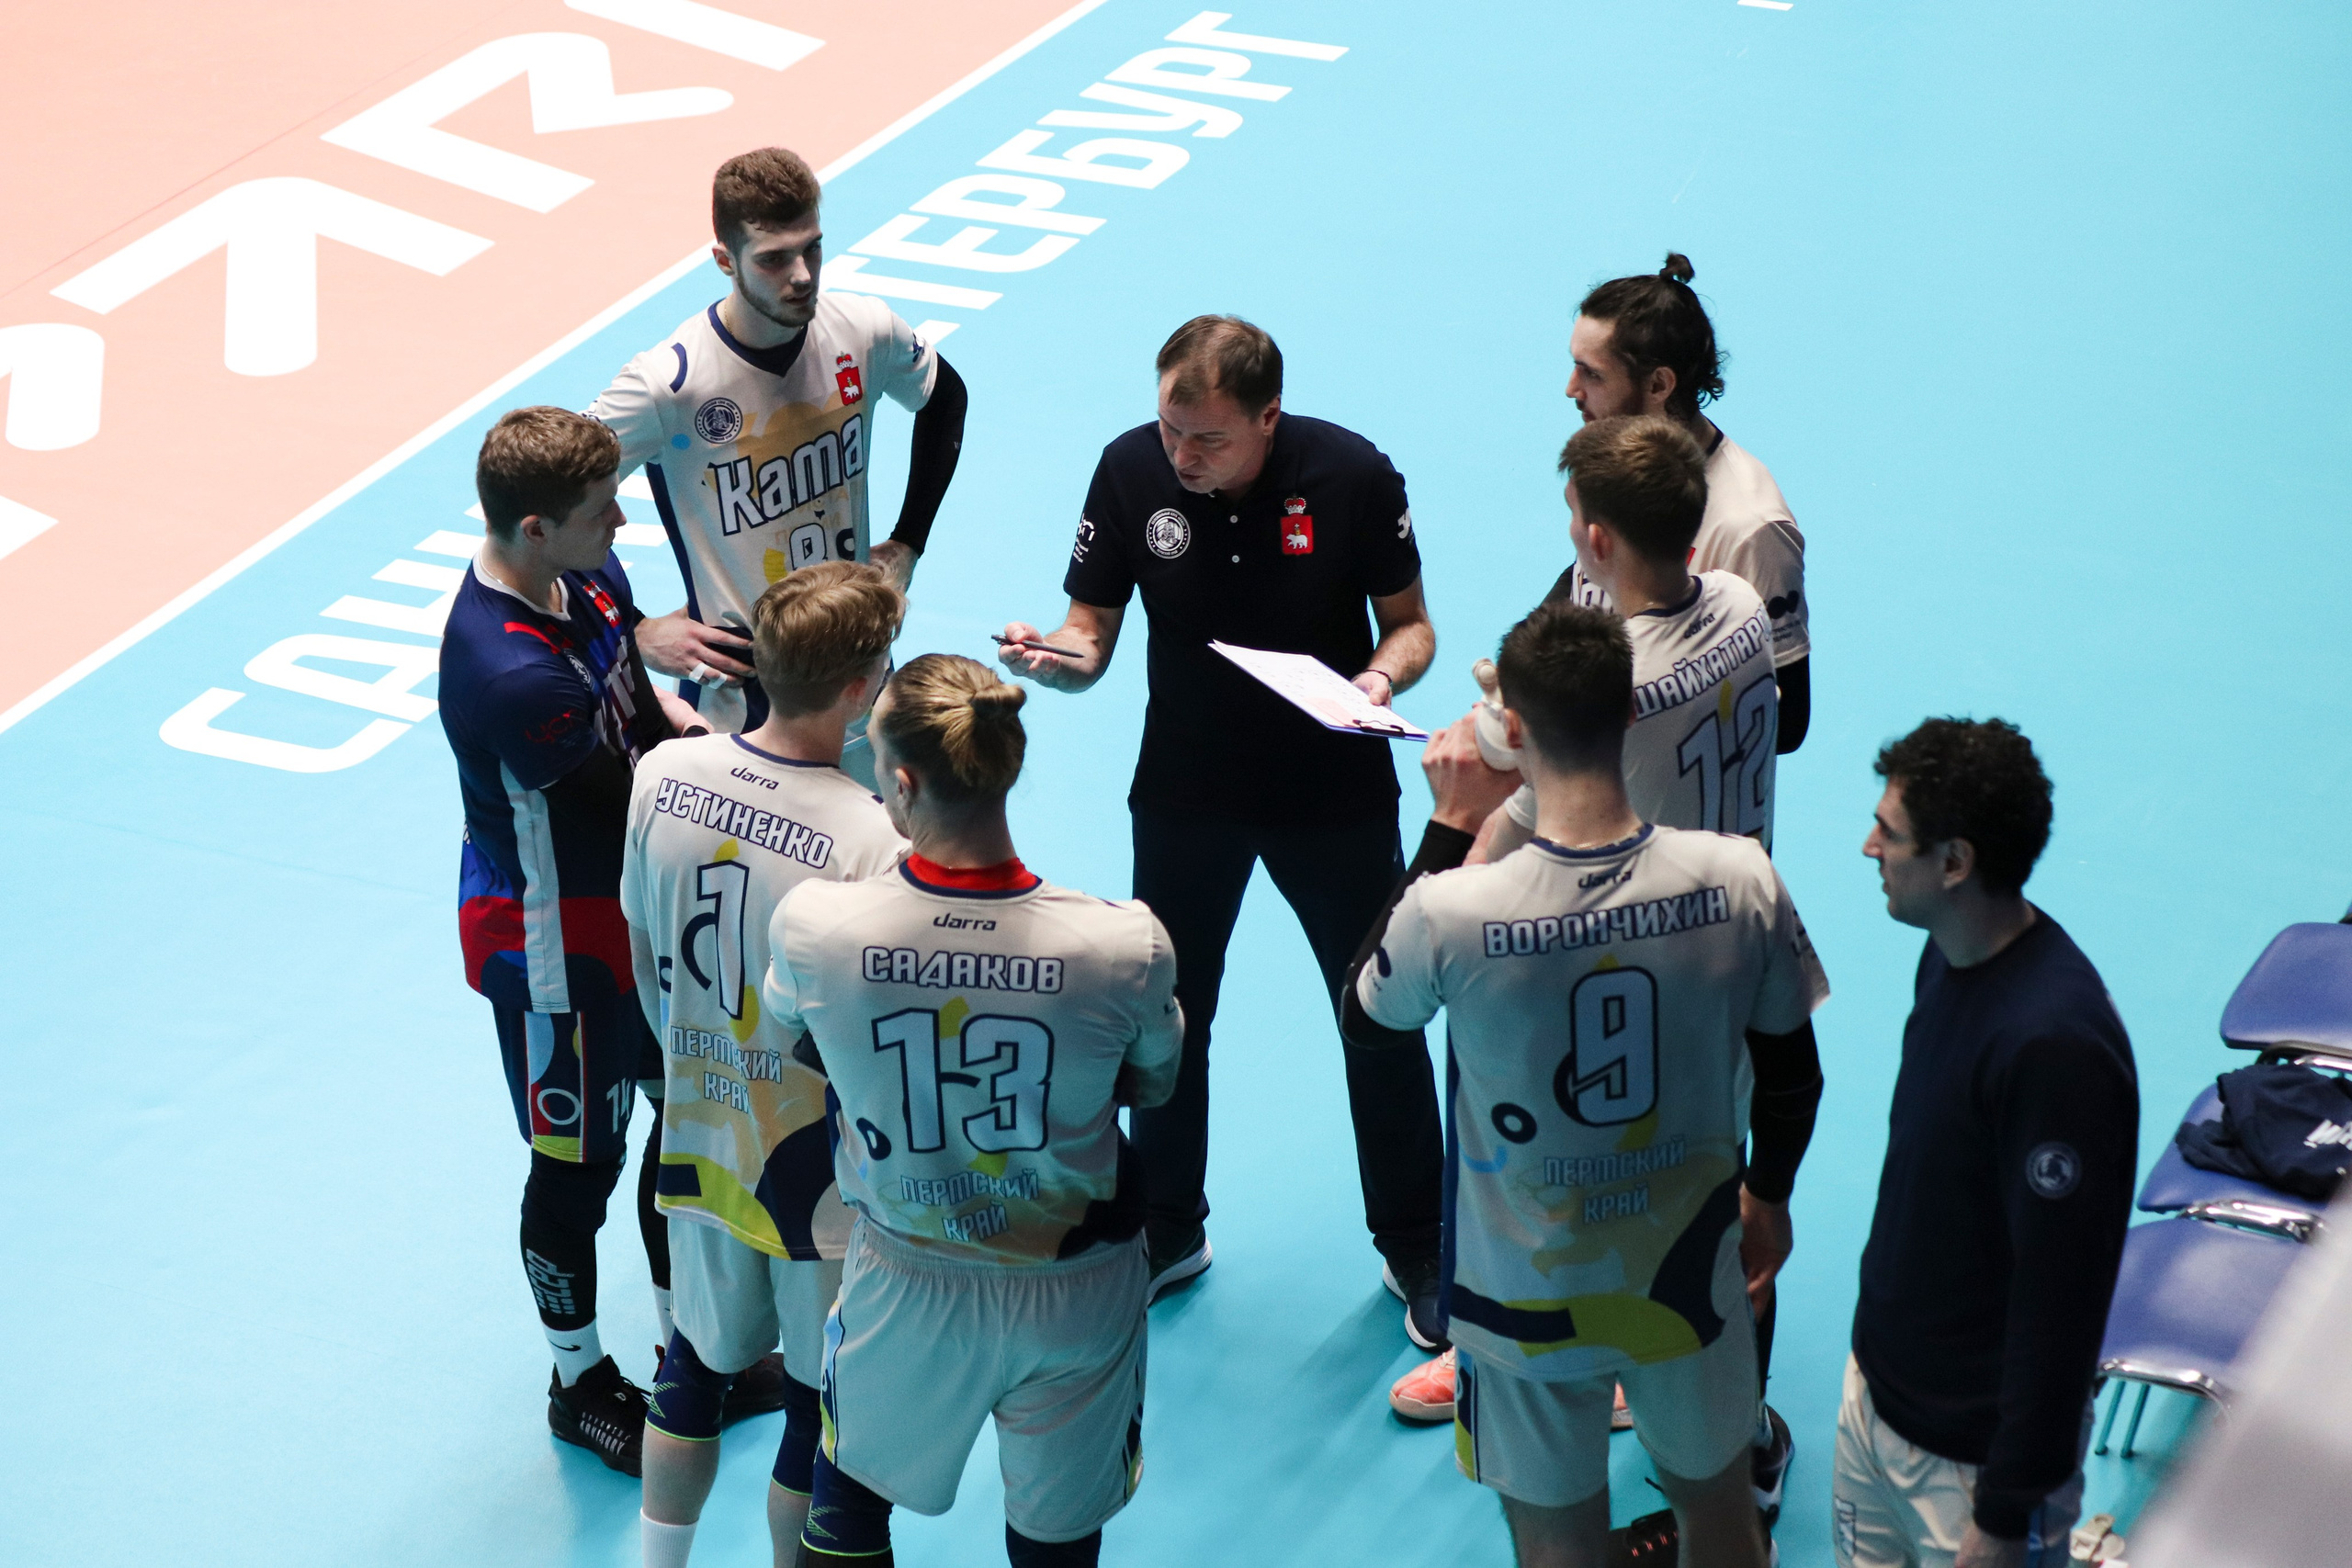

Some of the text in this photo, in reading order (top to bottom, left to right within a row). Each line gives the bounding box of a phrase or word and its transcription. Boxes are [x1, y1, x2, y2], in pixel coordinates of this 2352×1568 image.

[729, 767, 780, 790] darra
[1677, 672, 1776, 836] 12
[655, 778, 833, 869] УСТИНЕНКО
[697, 860, 750, 1021] 1
[933, 912, 996, 931] darra
[1483, 886, 1731, 958] ВОРОНЧИХИН
[863, 946, 1064, 995] САДАКОВ
[671, 1025, 782, 1084] ПЕРМСКИЙ
[1570, 966, 1659, 1128] 9
[872, 1007, 1055, 1155] 13
[900, 1168, 1039, 1207] ПЕРМСКИЙ
[1544, 1133, 1685, 1186] ПЕРМСКИЙ
[942, 1200, 1009, 1243] КРАЙ
[1583, 1181, 1650, 1224] КРАЙ
